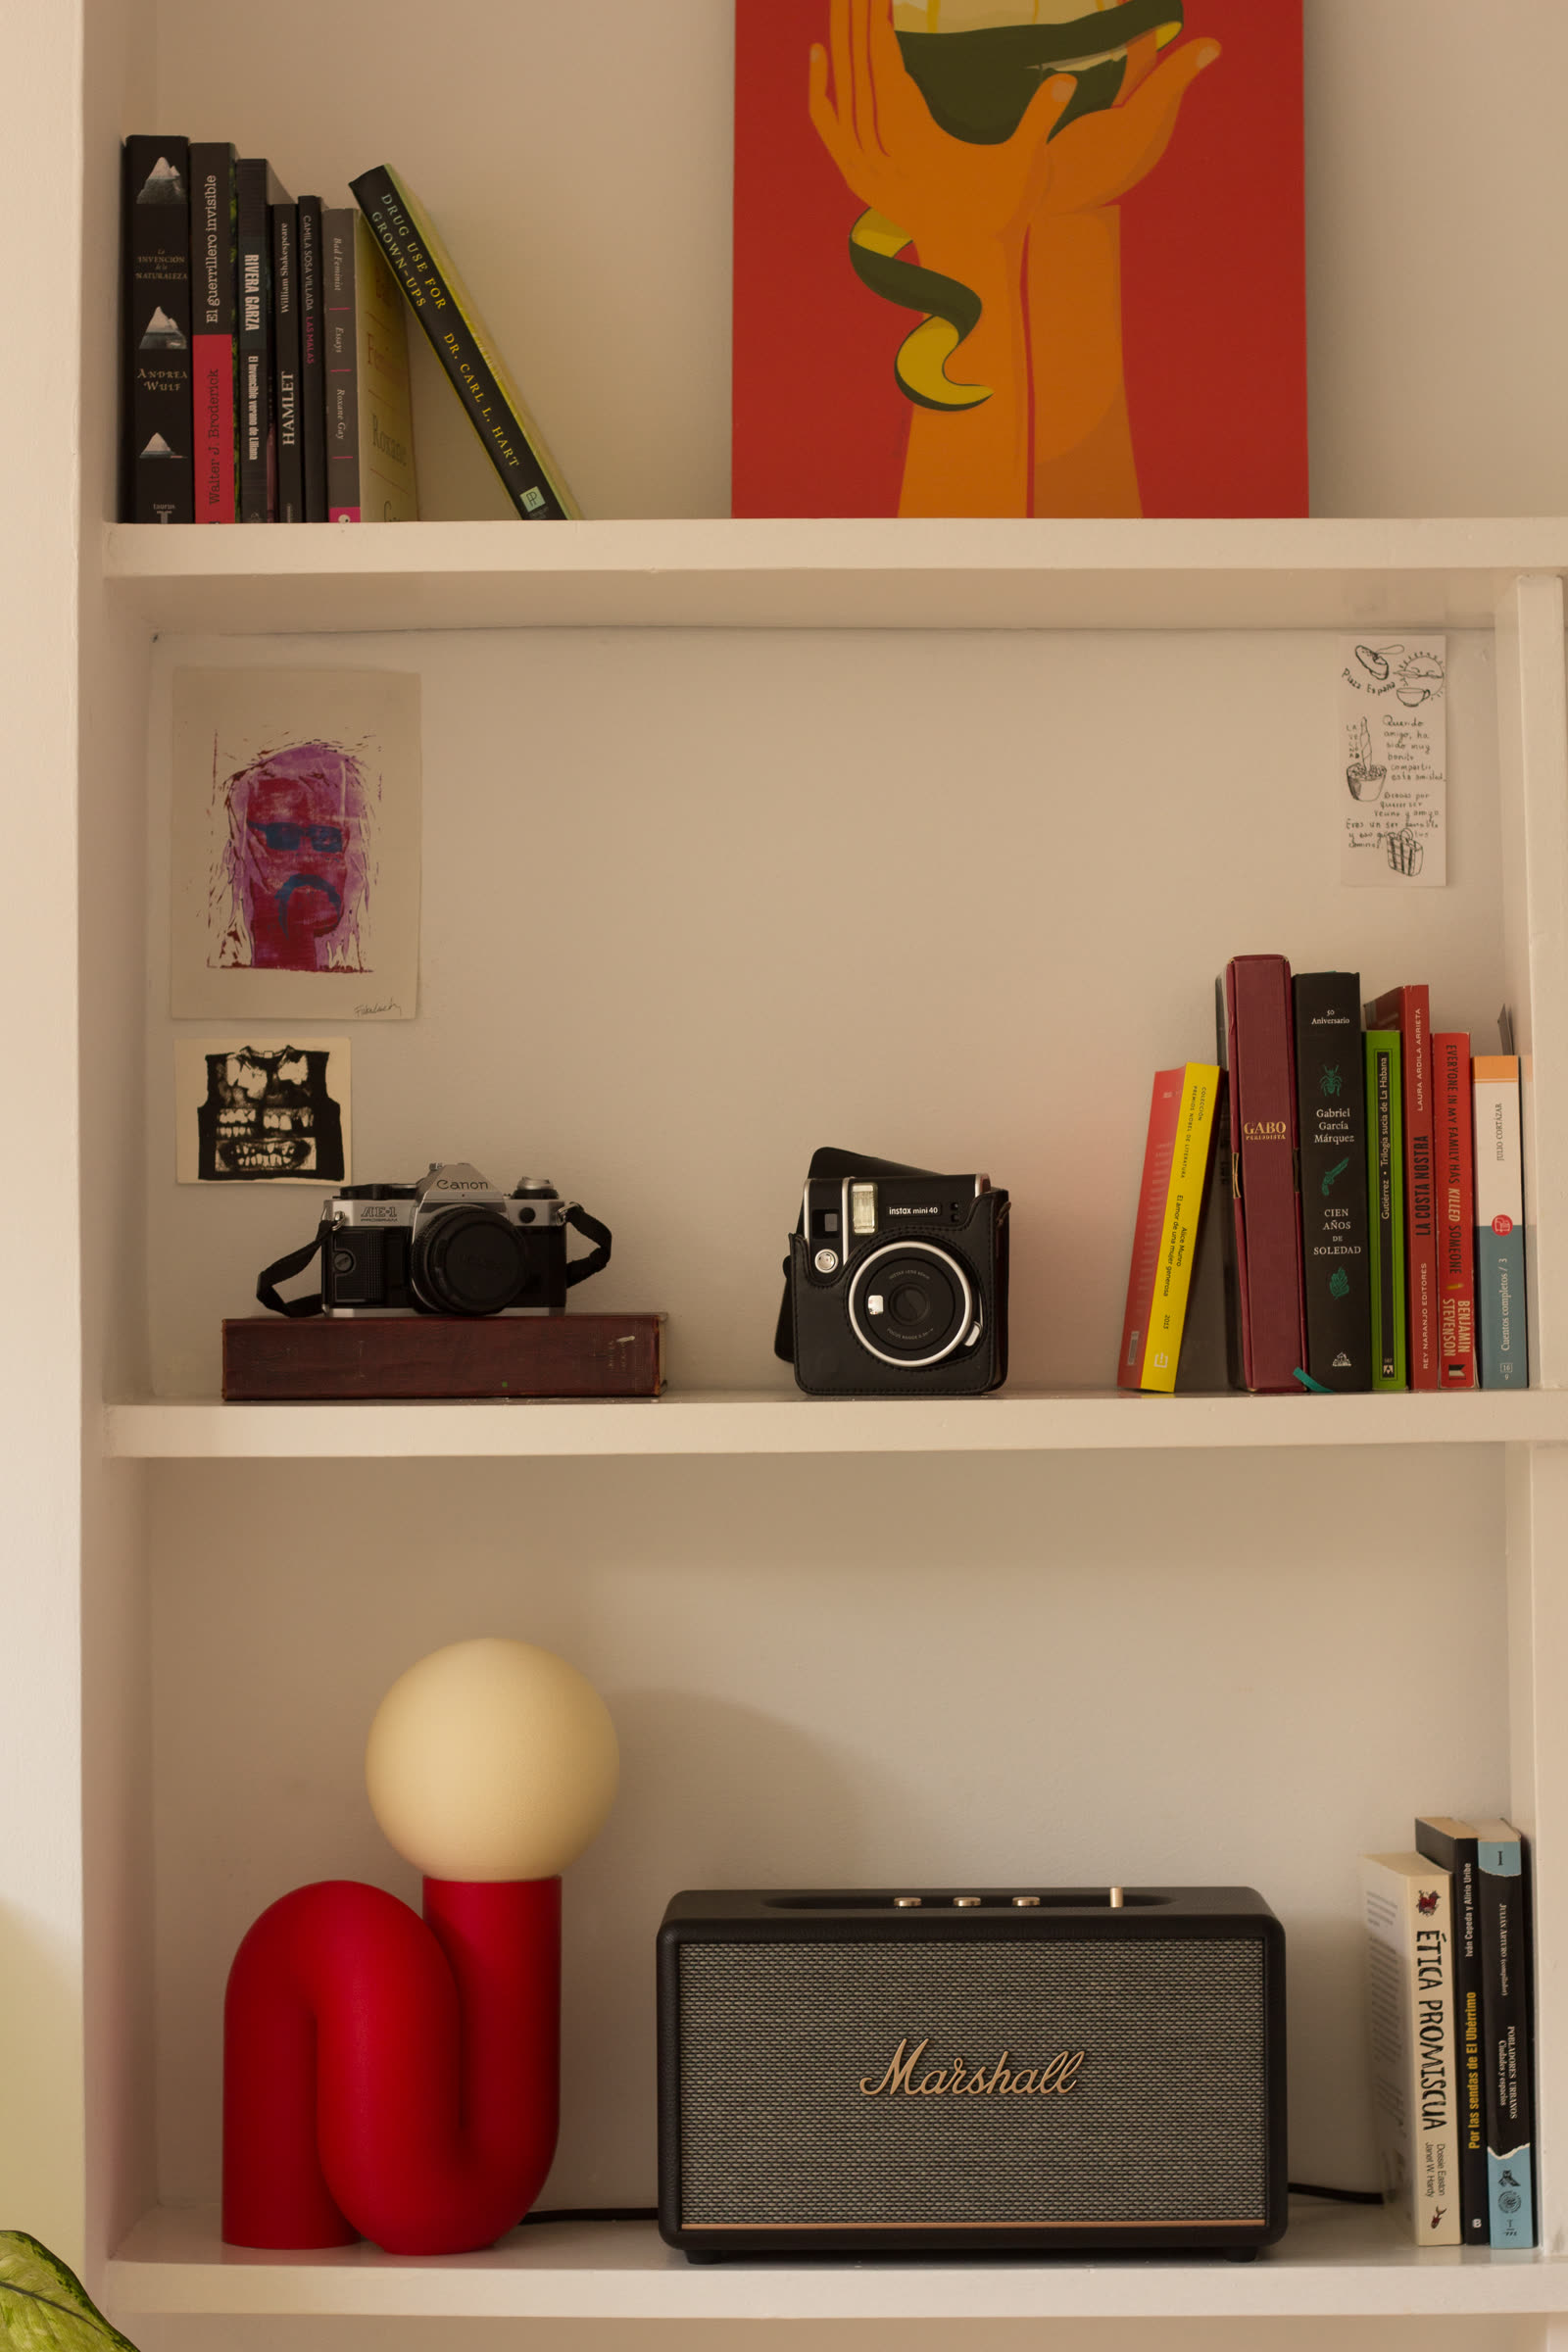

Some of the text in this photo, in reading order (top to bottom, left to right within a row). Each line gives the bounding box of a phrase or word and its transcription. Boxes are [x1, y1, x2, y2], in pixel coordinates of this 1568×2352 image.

[303, 215, 312, 249] CAMILA
[205, 174, 220, 323] El guerrillero invisible
[304, 250, 314, 273] SOSA
[333, 237, 343, 291] Bad Feminist
[371, 212, 426, 309] GROWN-UPS
[381, 193, 447, 310] DRUG USE FOR
[280, 222, 290, 314] William Shakespeare
[245, 254, 260, 331] RIVERA GARZA
[305, 274, 314, 311] VILLADA
[306, 333, 315, 365] MALAS
[335, 326, 344, 353] Essays
[137, 368, 188, 378] ANDREA
[249, 400, 258, 426] verano
[281, 370, 295, 445] HAMLET
[335, 388, 347, 440] Roxane Gay
[444, 333, 520, 468] DR. CARL L. HART
[208, 368, 220, 505] Walter J. Broderick
[249, 426, 259, 436] de
[249, 437, 260, 461] Liliana
[1383, 714, 1424, 727] Querido
[1411, 744, 1431, 755] muy
[1198, 1086, 1207, 1121] COLECCIÓN
[1316, 1108, 1350, 1118] Gabriel
[1244, 1121, 1287, 1135] GABO
[1314, 1134, 1354, 1146] Márquez
[1318, 1120, 1349, 1131] García
[1379, 1057, 1391, 1220] Gutiérrez Trilogía sucia de La Habana
[1494, 1102, 1505, 1161] JULIO CORTÁZAR
[1180, 1144, 1191, 1179] LITERATURA
[1446, 1045, 1462, 1274] EVERYONE IN MY FAMILY HAS KILLED SOMEONE
[436, 1179, 489, 1190] Canon
[1413, 1135, 1431, 1236] LA COSTA NOSTRA
[889, 1206, 911, 1215] instax
[1173, 1202, 1182, 1220] amor
[1173, 1221, 1179, 1230] de
[1323, 1219, 1351, 1230] AÑOS
[1324, 1208, 1349, 1217] CIEN
[1167, 1246, 1176, 1265] mujer
[1176, 1245, 1185, 1267] Munro
[1313, 1246, 1361, 1255] SOLEDAD
[1163, 1266, 1173, 1297] generosa
[1498, 1273, 1511, 1315] completos
[1443, 1298, 1456, 1356] STEVENSON
[1458, 1300, 1471, 1353] BENJAMIN
[1501, 1317, 1510, 1351] Cuentos
[1463, 1863, 1472, 1884] Uribe
[1463, 1884, 1472, 1905] Alirio
[1464, 1912, 1474, 1939] Cepeda
[1416, 1930, 1447, 2132] ÉTICA PROMISCUA
[859, 2037, 1085, 2096] Marshall
[1465, 1991, 1480, 2149] Por las sendas de El Ubérrimo
[1507, 2026, 1518, 2120] POBLADORES URBANOS
[1425, 2142, 1435, 2163] Janet
[1437, 2143, 1446, 2196] Dossie Easton
[1425, 2177, 1435, 2198] Hardy
